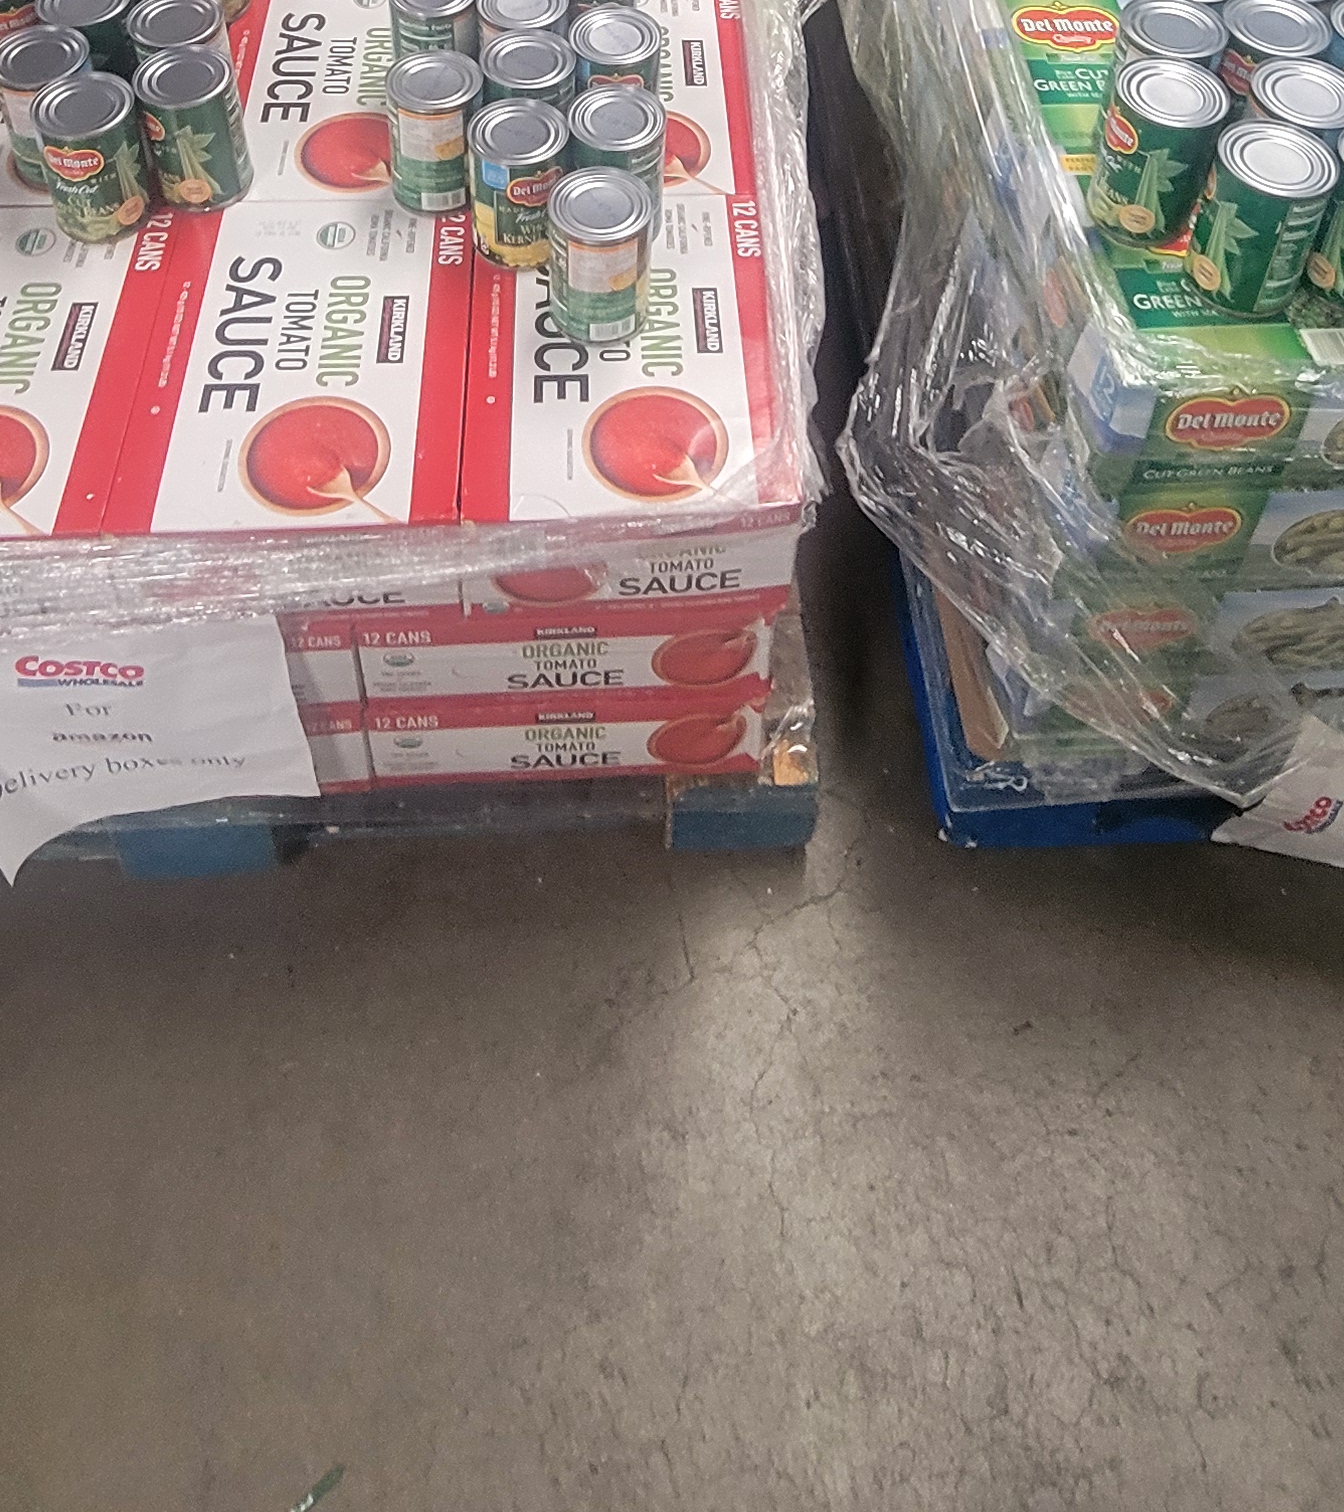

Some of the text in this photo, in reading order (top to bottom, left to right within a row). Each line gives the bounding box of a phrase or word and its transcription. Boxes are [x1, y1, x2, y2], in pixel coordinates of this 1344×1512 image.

[1019, 17, 1114, 33] Del Monte
[259, 11, 328, 125] SAUCE
[321, 36, 358, 96] TOMATO
[689, 41, 705, 85] KIRKLAND
[1033, 78, 1092, 92] GREEN
[731, 200, 762, 259] 12 CANS
[134, 212, 174, 272] 12 CANS
[437, 224, 466, 266] CANS
[1133, 293, 1203, 310] GREEN
[274, 289, 320, 372] TOMATO
[315, 274, 372, 387] ORGANIC
[385, 298, 408, 362] KIRKLAND
[640, 267, 685, 379] ORGANIC
[698, 290, 721, 352] KIRKLAND
[65, 304, 98, 371] KIRKLAND
[197, 255, 284, 414] SAUCE
[1177, 408, 1281, 430] Del Monte
[1141, 463, 1275, 480] CUT GREEN BEANS
[1136, 517, 1234, 536] Del Monte
[648, 557, 715, 574] TOMATO
[617, 568, 743, 597] SAUCE
[362, 630, 432, 646] 12 CANS
[521, 640, 611, 659] ORGANIC
[14, 654, 146, 681] COSTCO
[534, 657, 599, 671] TOMATO
[56, 678, 145, 688] WHOLESALE
[506, 668, 625, 689] SAUCE
[64, 702, 112, 717] For
[373, 714, 439, 729] 12 CANS
[52, 730, 153, 744] amazon
[524, 725, 607, 742] ORGANIC
[535, 740, 597, 753] TOMATO
[105, 757, 183, 776] boxes
[191, 754, 246, 770] only
[510, 751, 622, 770] SAUCE
